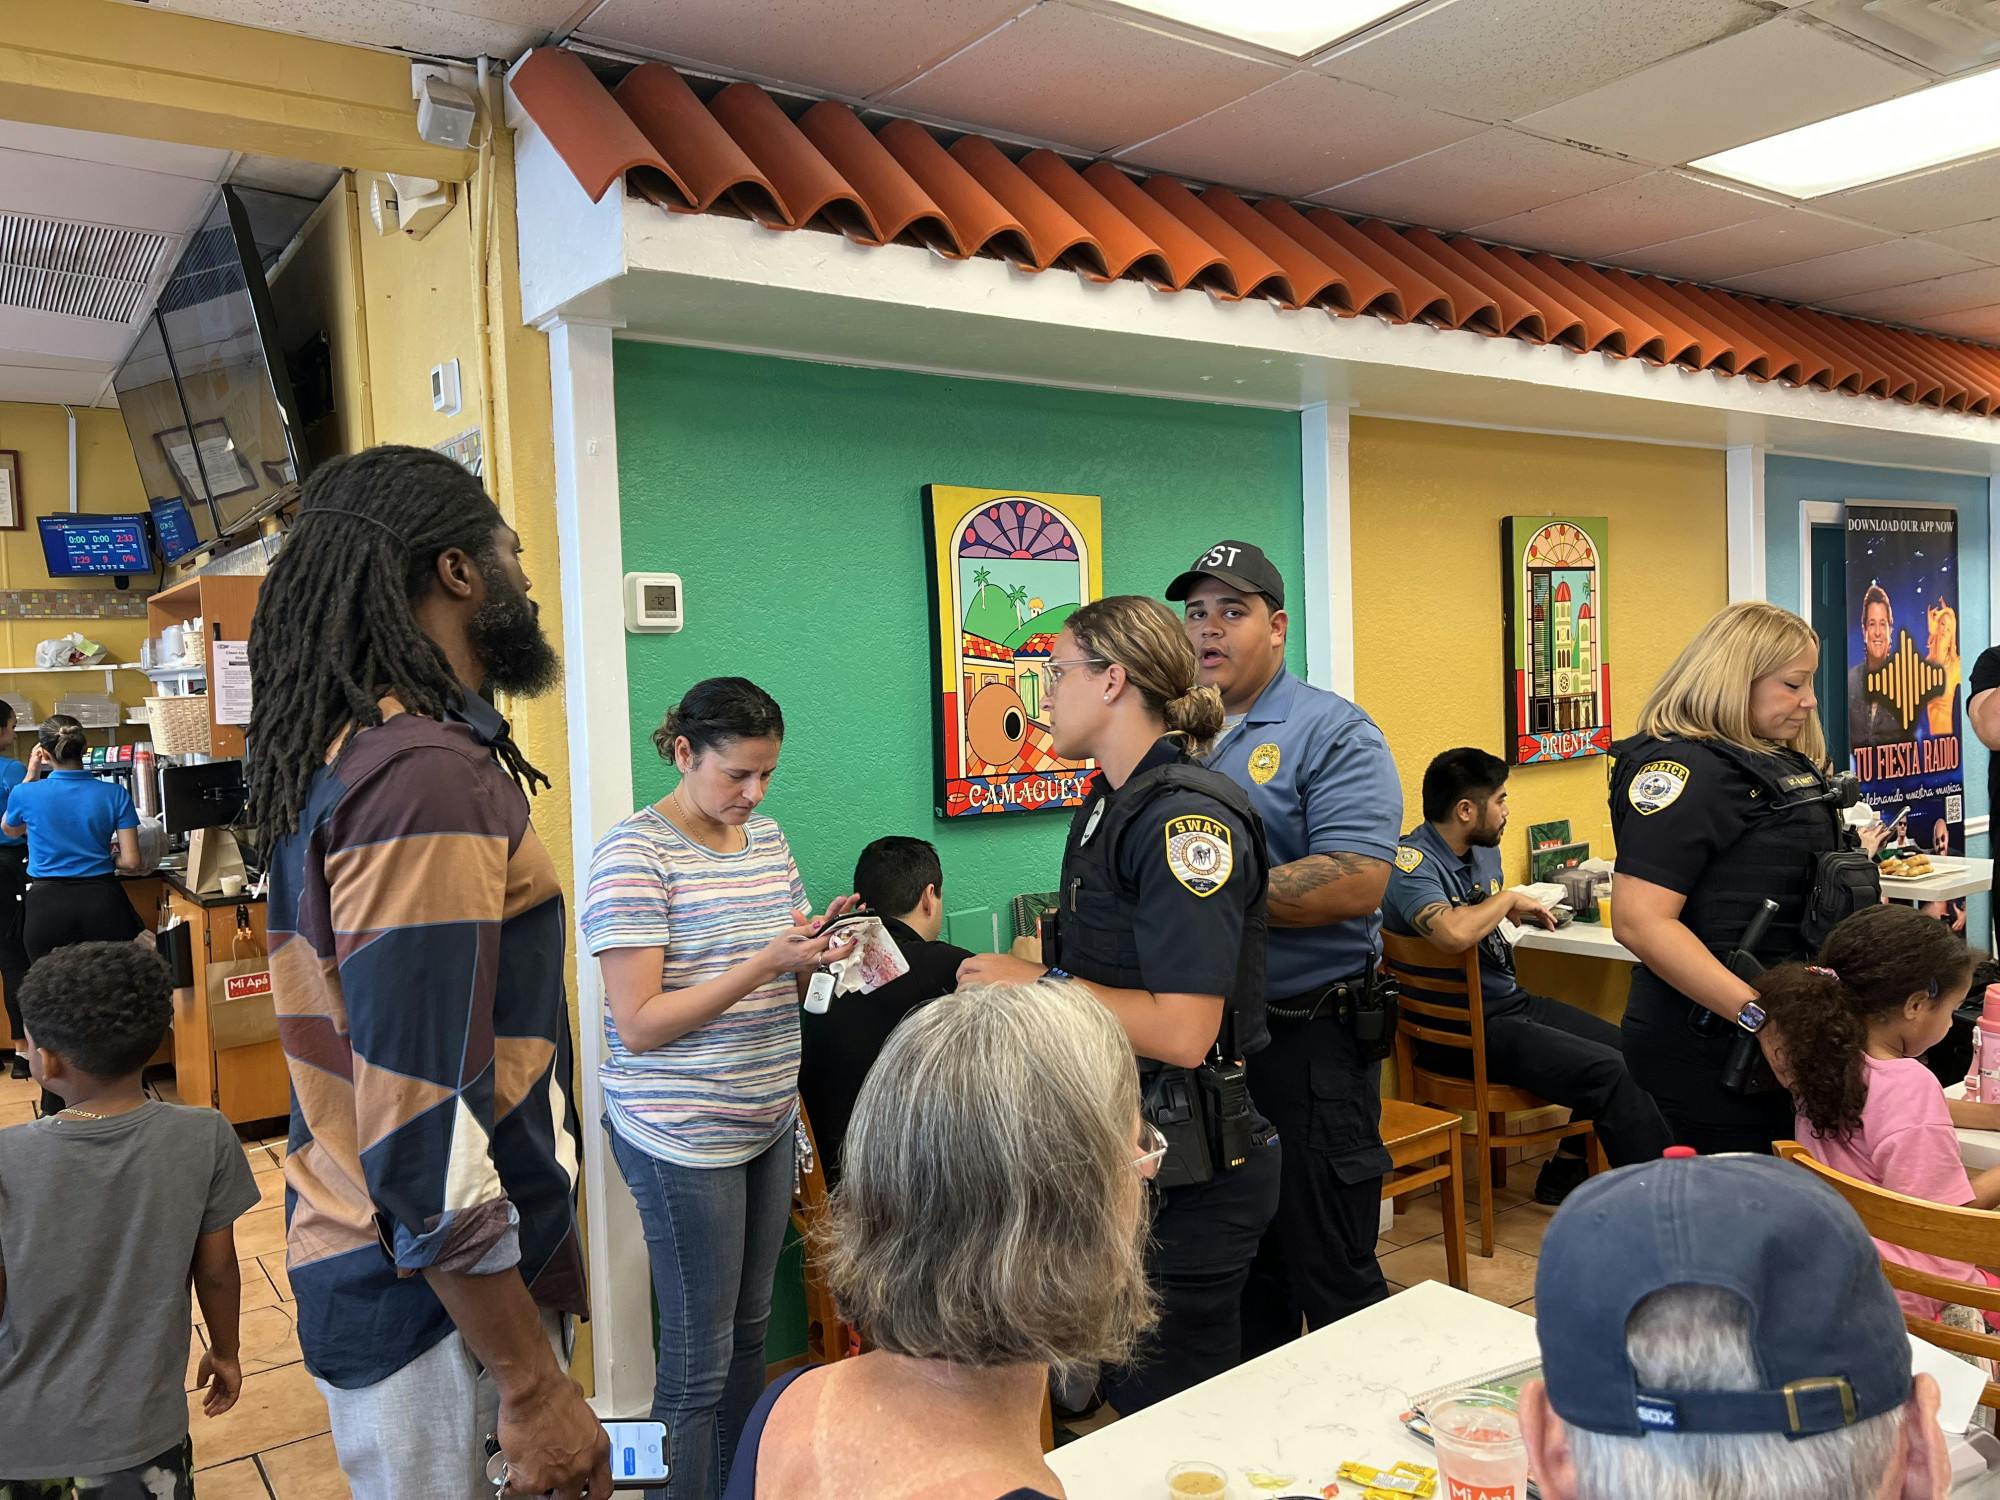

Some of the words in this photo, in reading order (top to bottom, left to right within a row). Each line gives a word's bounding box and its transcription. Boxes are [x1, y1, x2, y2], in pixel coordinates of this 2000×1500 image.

[1848, 518, 1899, 532] DOWNLOAD
[1900, 519, 1919, 532] OUR
[1919, 520, 1935, 533] APP
[1935, 520, 1954, 533] NOW
[69, 535, 86, 543] 0:00
[92, 535, 109, 543] 0:00
[1540, 731, 1593, 754] ORIENTE
[1854, 746, 1872, 782] TU
[1877, 741, 1921, 780] FIESTA
[1923, 736, 1959, 773] RADIO
[1641, 762, 1685, 779] POLICE
[969, 775, 1085, 806] CAMAGÜEY
[1906, 784, 1934, 800] nuestra
[1175, 819, 1222, 837] SWAT
[230, 979, 245, 990] Mi
[247, 974, 268, 988] Apá
[1636, 1406, 1674, 1425] SOX
[1451, 1481, 1471, 1500] Mi
